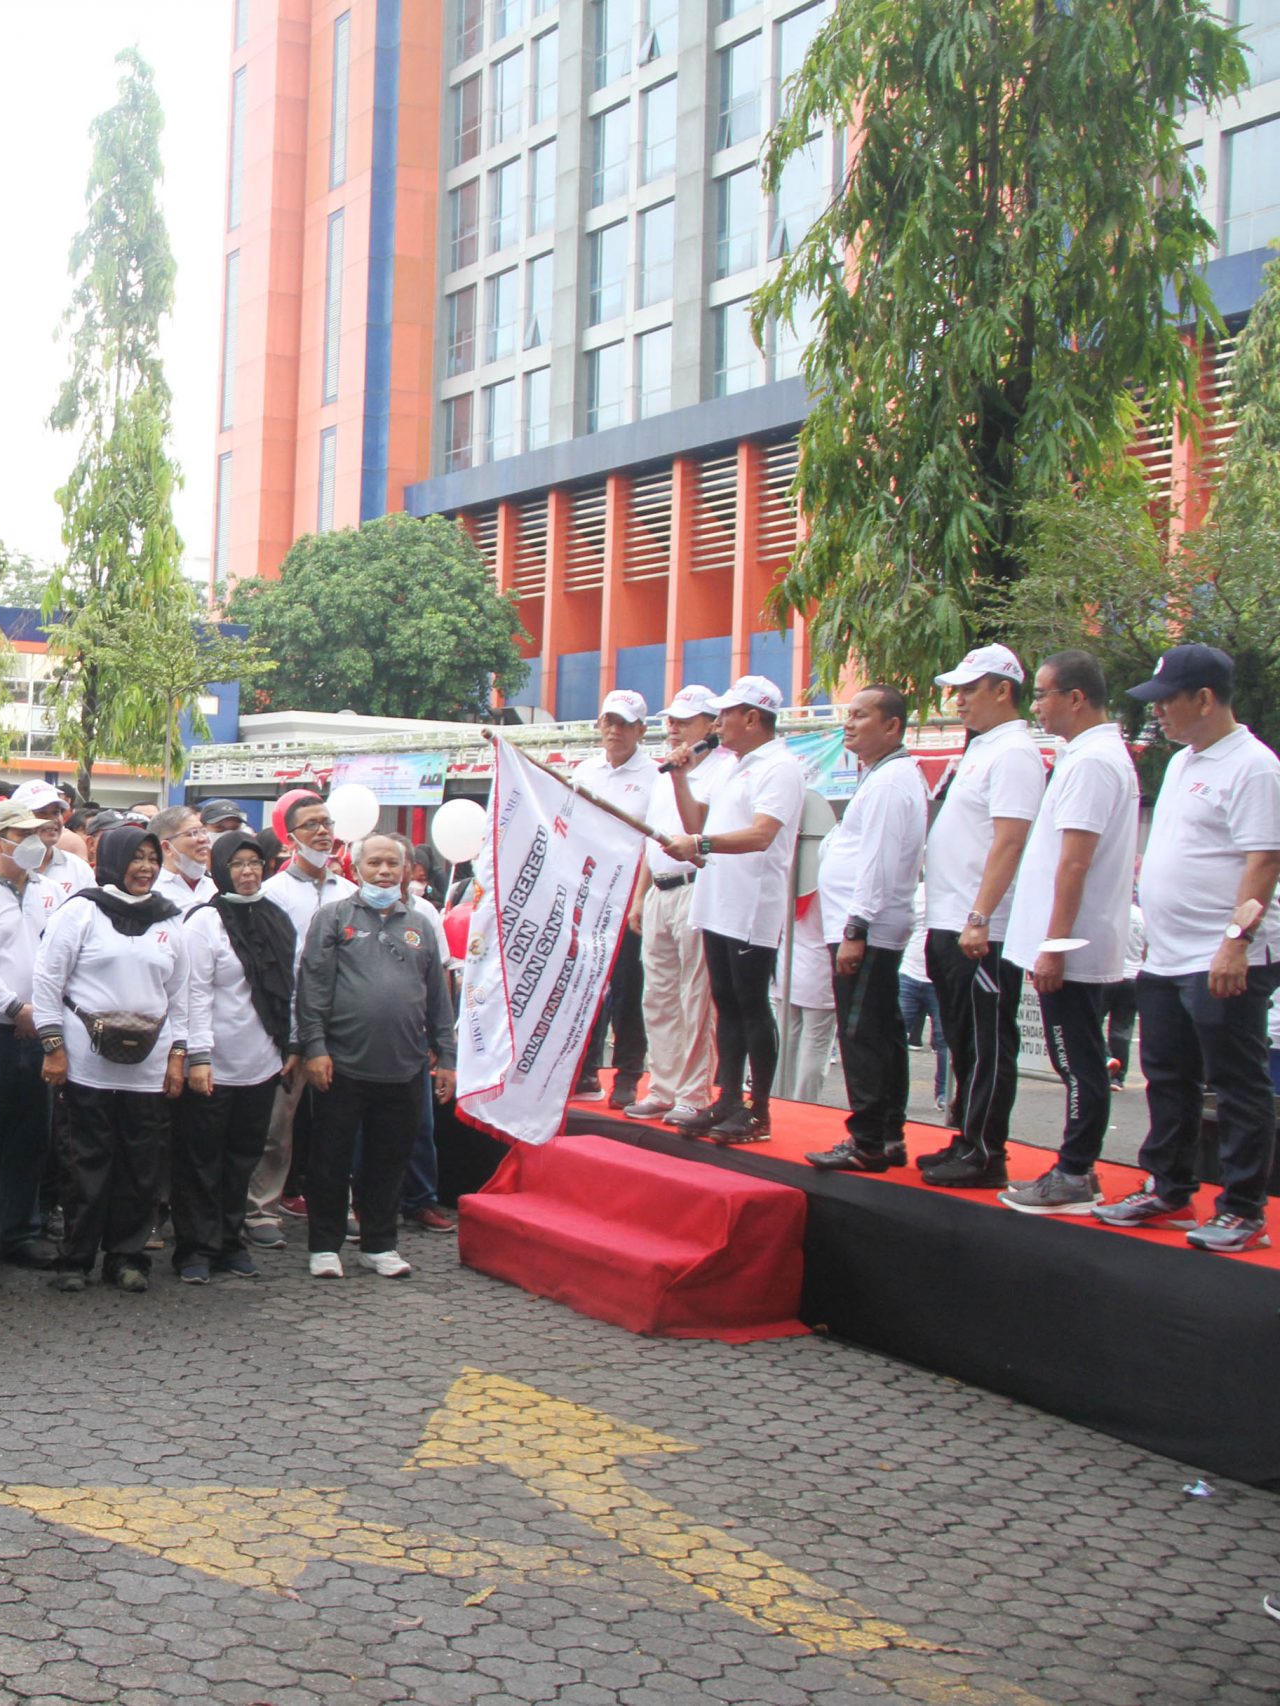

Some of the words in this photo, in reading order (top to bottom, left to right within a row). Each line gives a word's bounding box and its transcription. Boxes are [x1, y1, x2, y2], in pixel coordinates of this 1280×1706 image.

[508, 825, 549, 908] BEREGU
[507, 919, 540, 964] DAN
[510, 955, 547, 1018] JALAN
[536, 884, 567, 956] SANTAI
[470, 1010, 485, 1053] SUMUT
[517, 1021, 551, 1074] DALAM
[541, 956, 577, 1023] RANGKA
